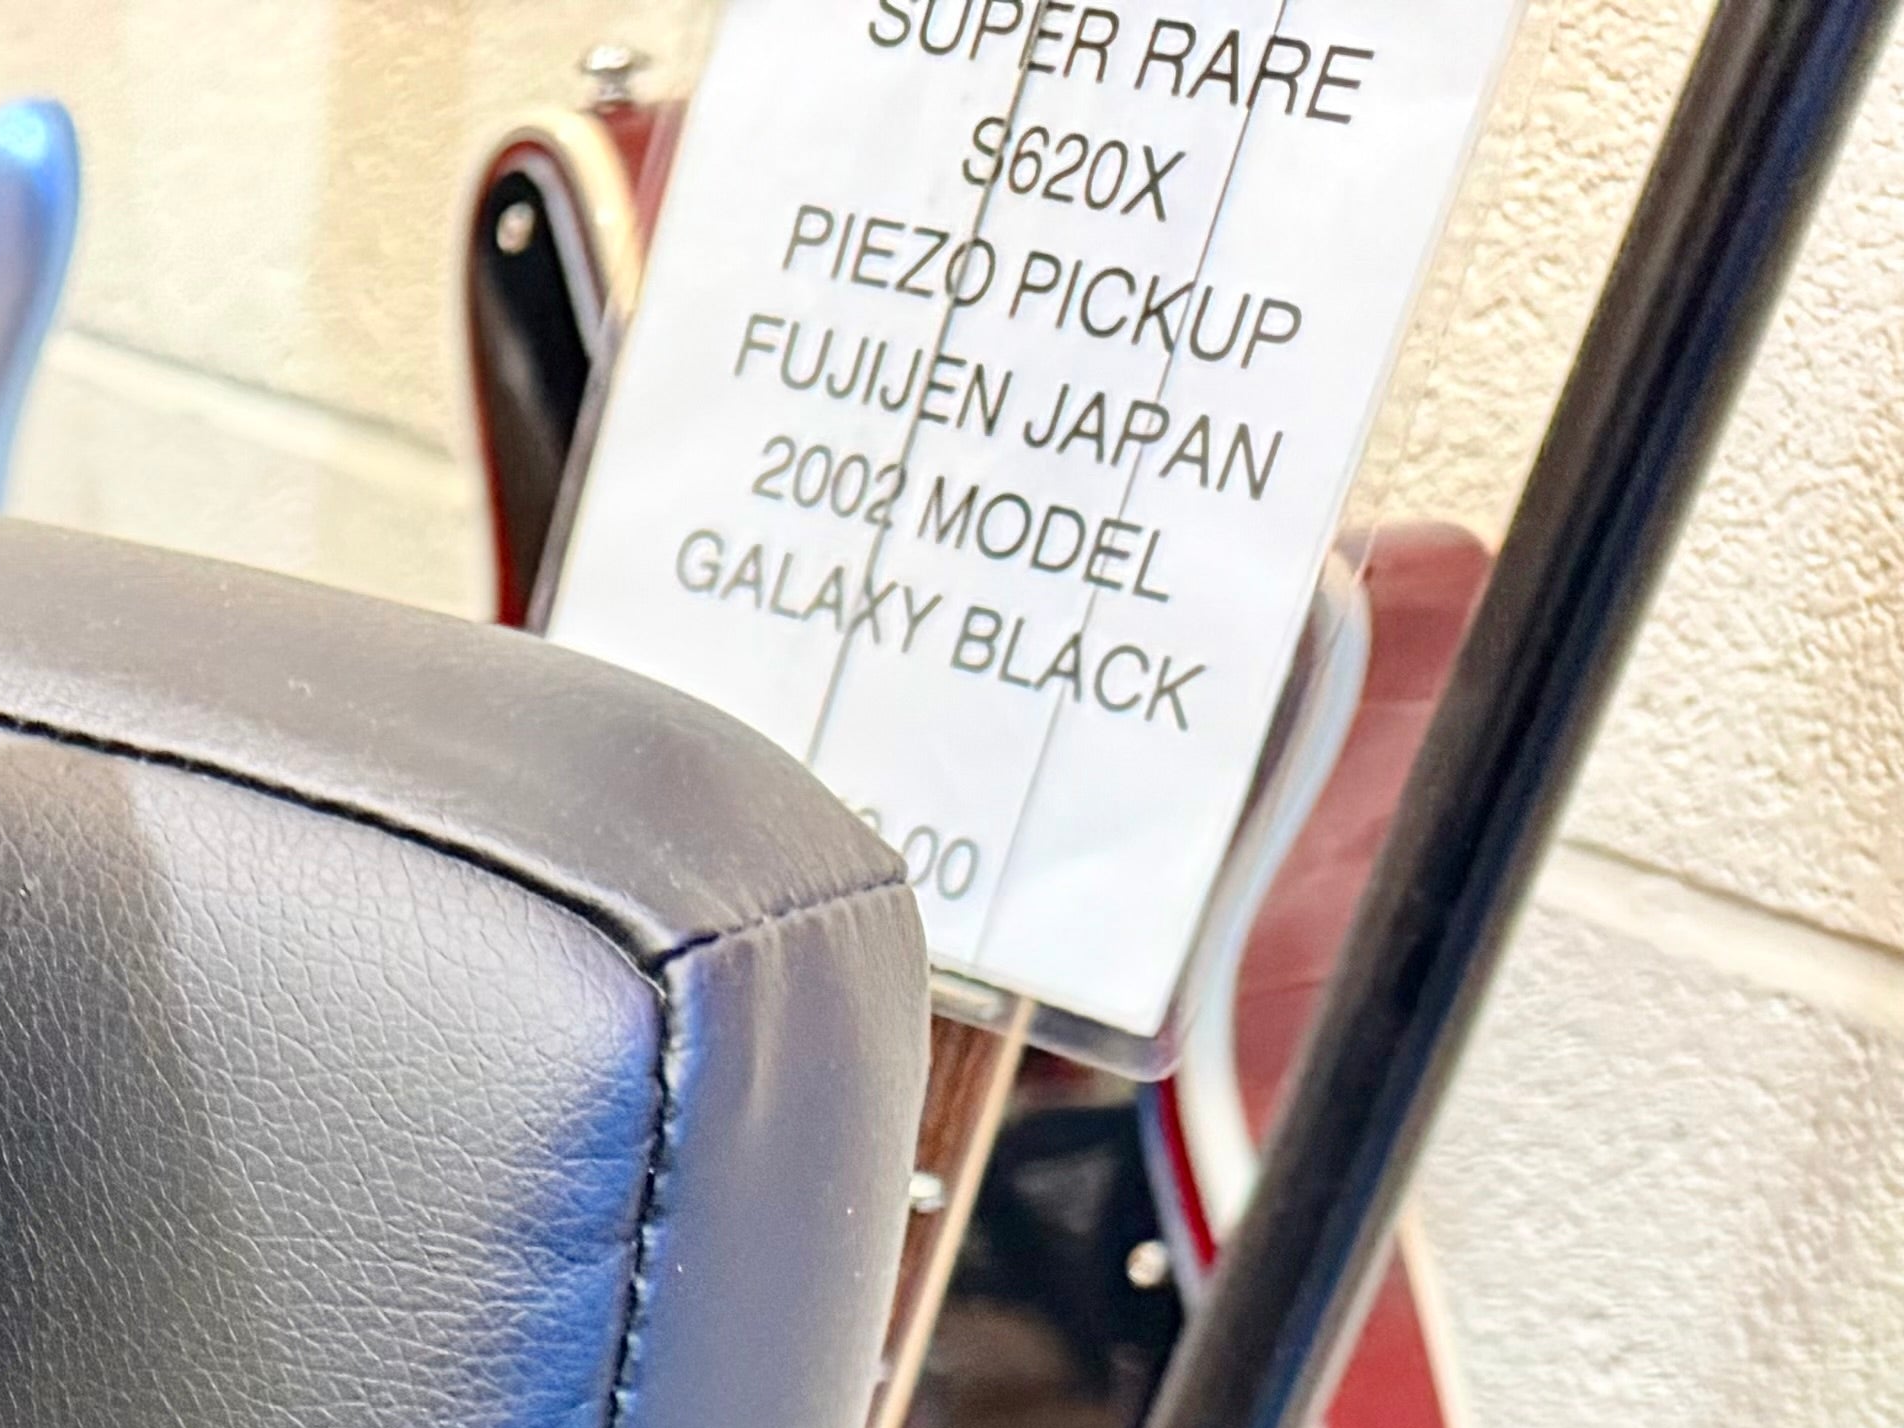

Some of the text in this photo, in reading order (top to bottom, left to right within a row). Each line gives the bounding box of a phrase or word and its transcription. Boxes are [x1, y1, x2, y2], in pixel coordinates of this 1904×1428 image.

[869, 0, 1375, 124] SUPER RARE
[962, 116, 1186, 221] S620X
[782, 204, 1303, 369] PIEZO PICKUP
[734, 313, 1284, 501] FUJIJEN JAPAN
[751, 434, 1170, 603] 2002 MODEL
[675, 528, 1206, 733] GALAXY BLACK
